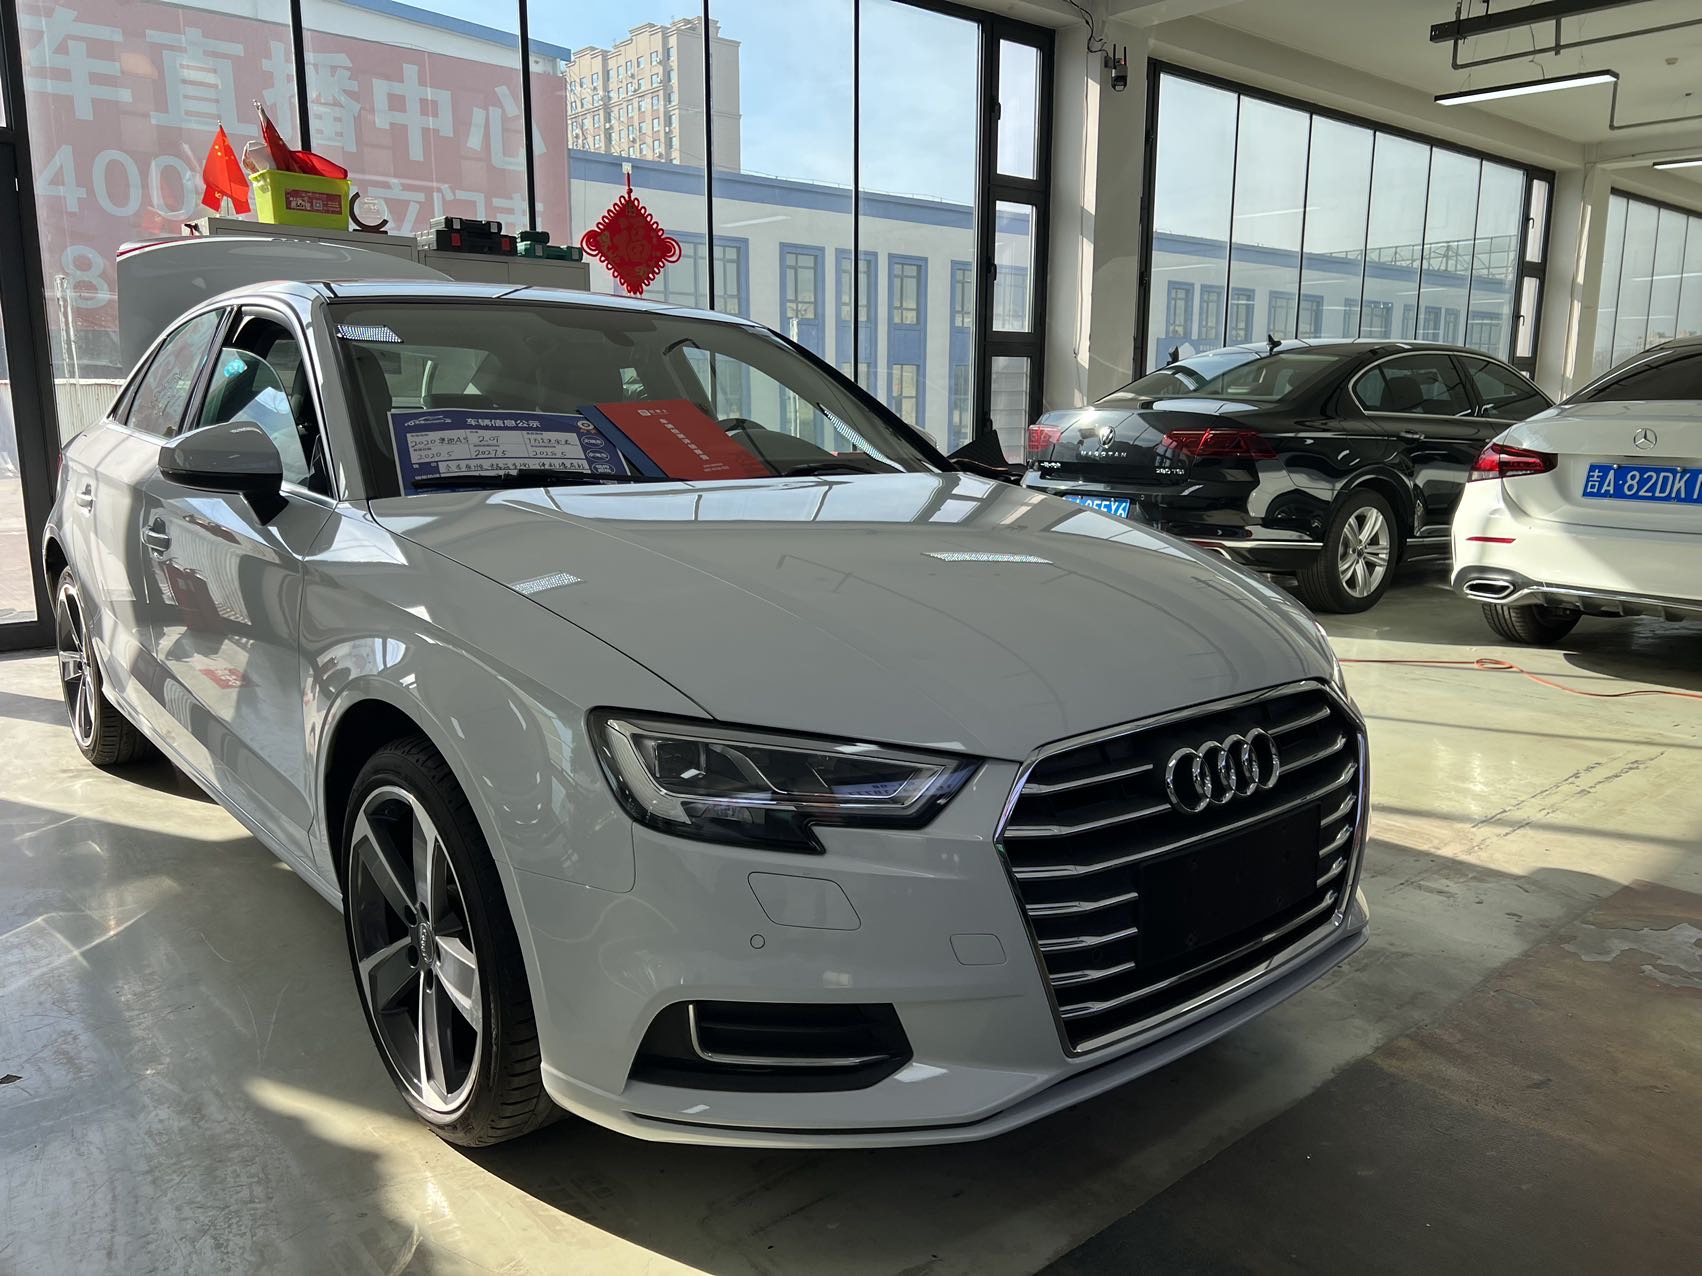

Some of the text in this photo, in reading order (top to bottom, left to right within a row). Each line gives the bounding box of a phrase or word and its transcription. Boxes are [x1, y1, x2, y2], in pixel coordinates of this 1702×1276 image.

[466, 418, 541, 428] 车辆信息公示
